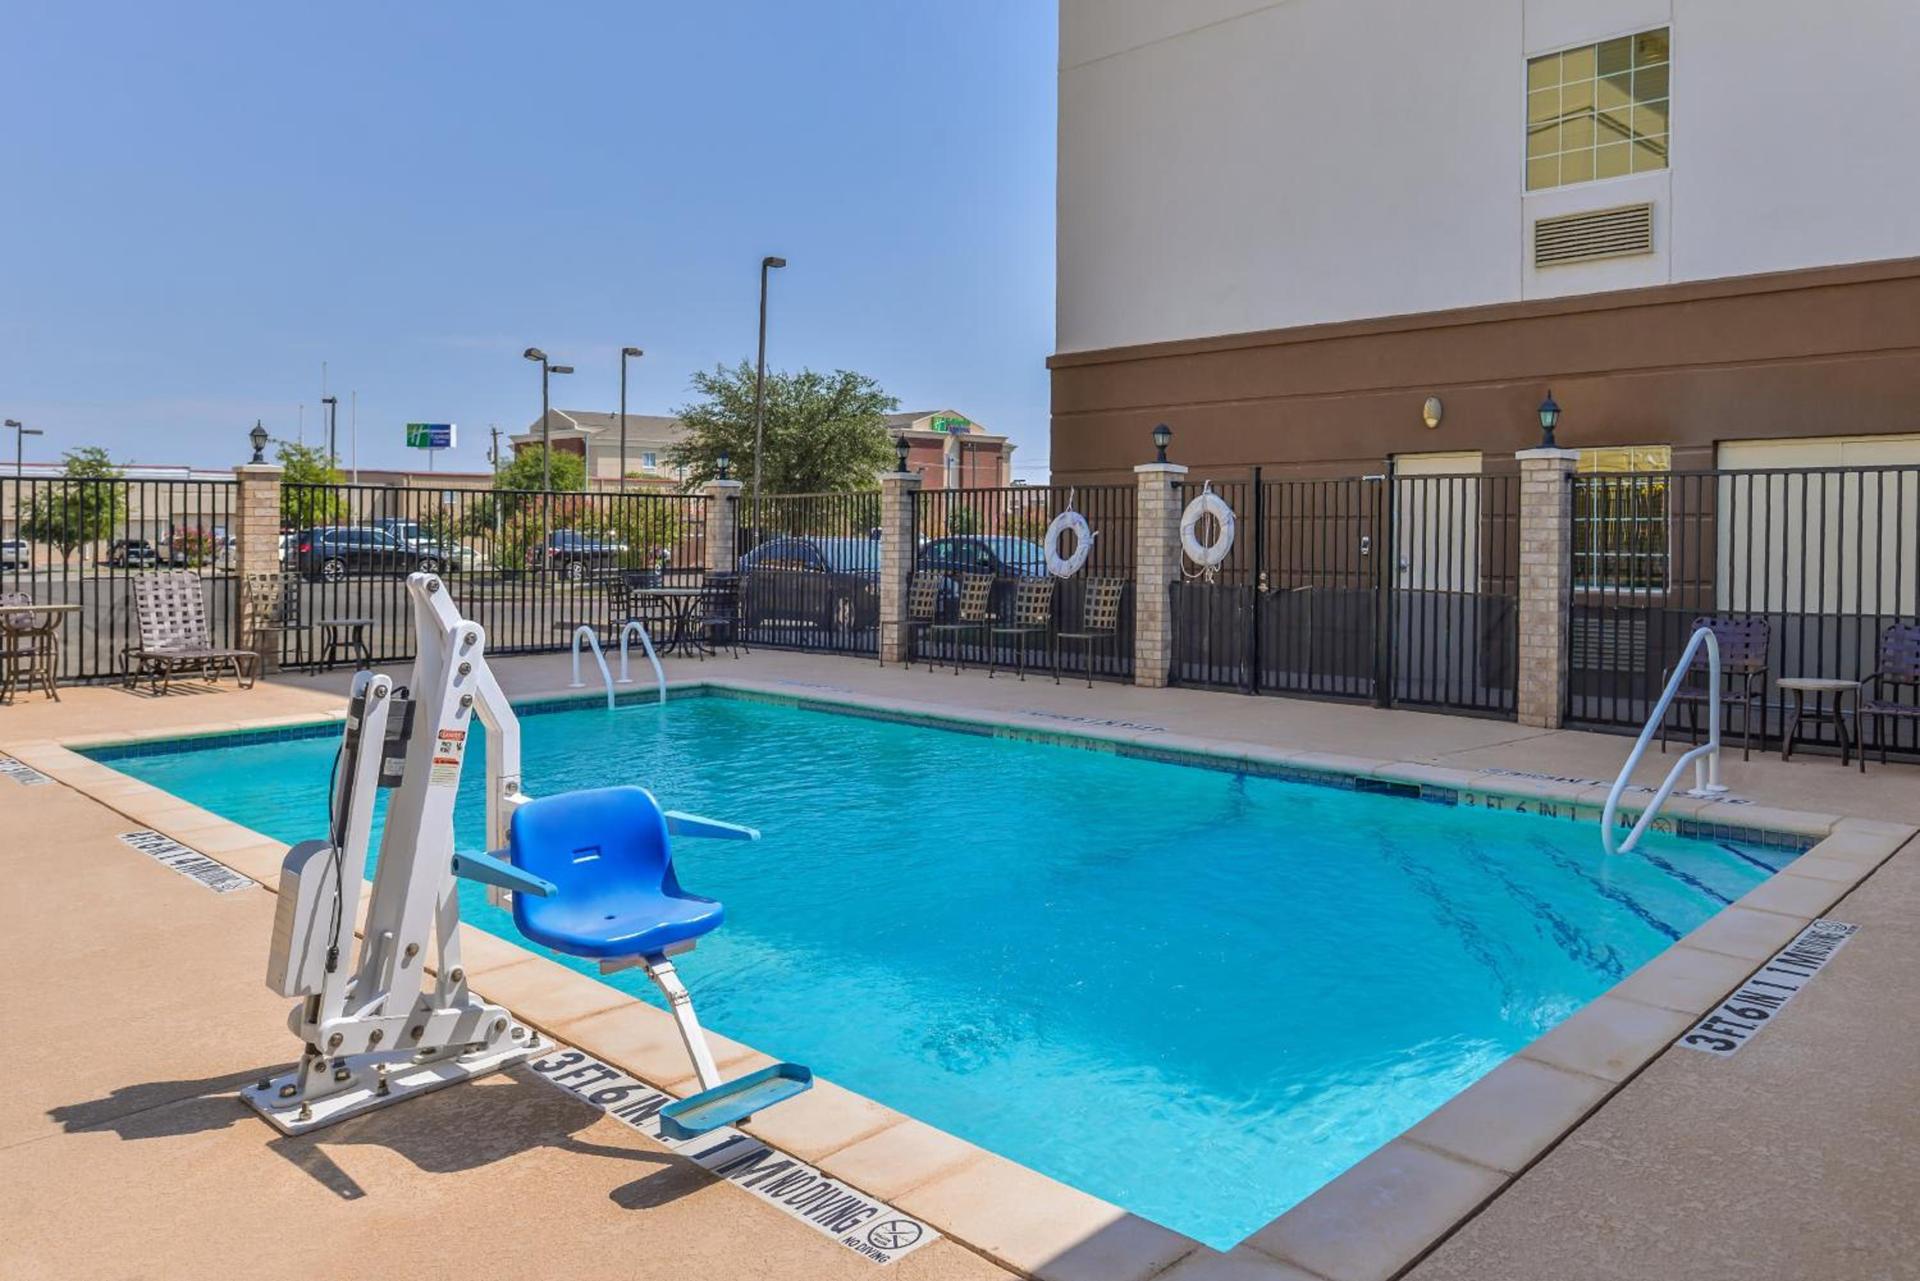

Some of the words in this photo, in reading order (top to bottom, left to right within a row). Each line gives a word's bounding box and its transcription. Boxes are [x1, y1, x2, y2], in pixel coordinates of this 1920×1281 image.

[1685, 1034, 1737, 1052] 3
[1722, 1003, 1770, 1021] 6
[532, 1052, 586, 1072] 3
[587, 1084, 647, 1104] 6
[715, 1147, 798, 1189] M
[758, 1168, 818, 1199] NO
[783, 1181, 879, 1234] DIVING
